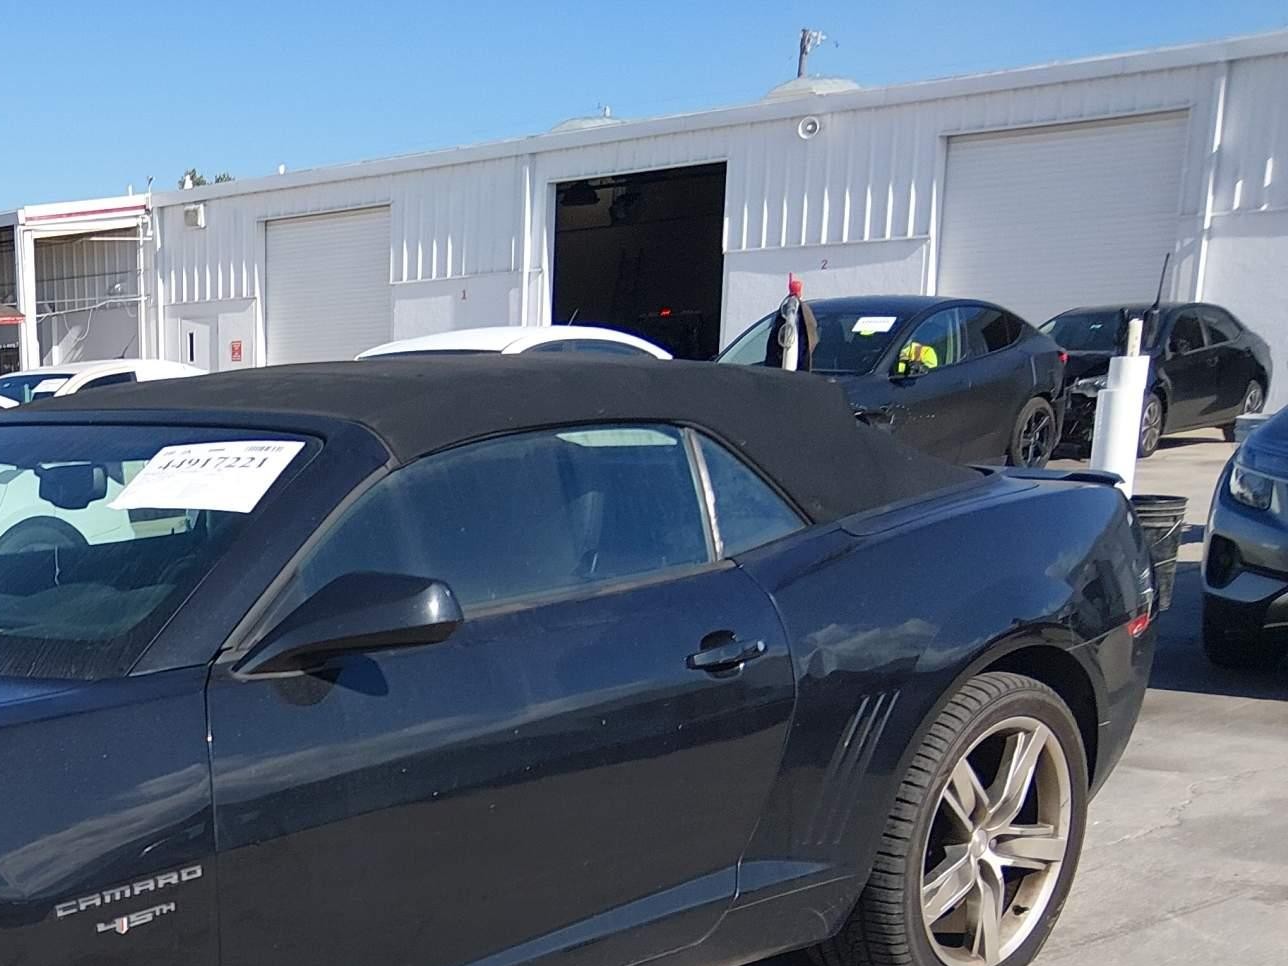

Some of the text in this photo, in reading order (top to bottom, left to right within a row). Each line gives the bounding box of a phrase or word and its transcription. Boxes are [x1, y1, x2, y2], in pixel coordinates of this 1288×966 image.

[821, 259, 828, 270] 2
[158, 456, 268, 470] 44917221
[55, 864, 203, 918] CAMARO
